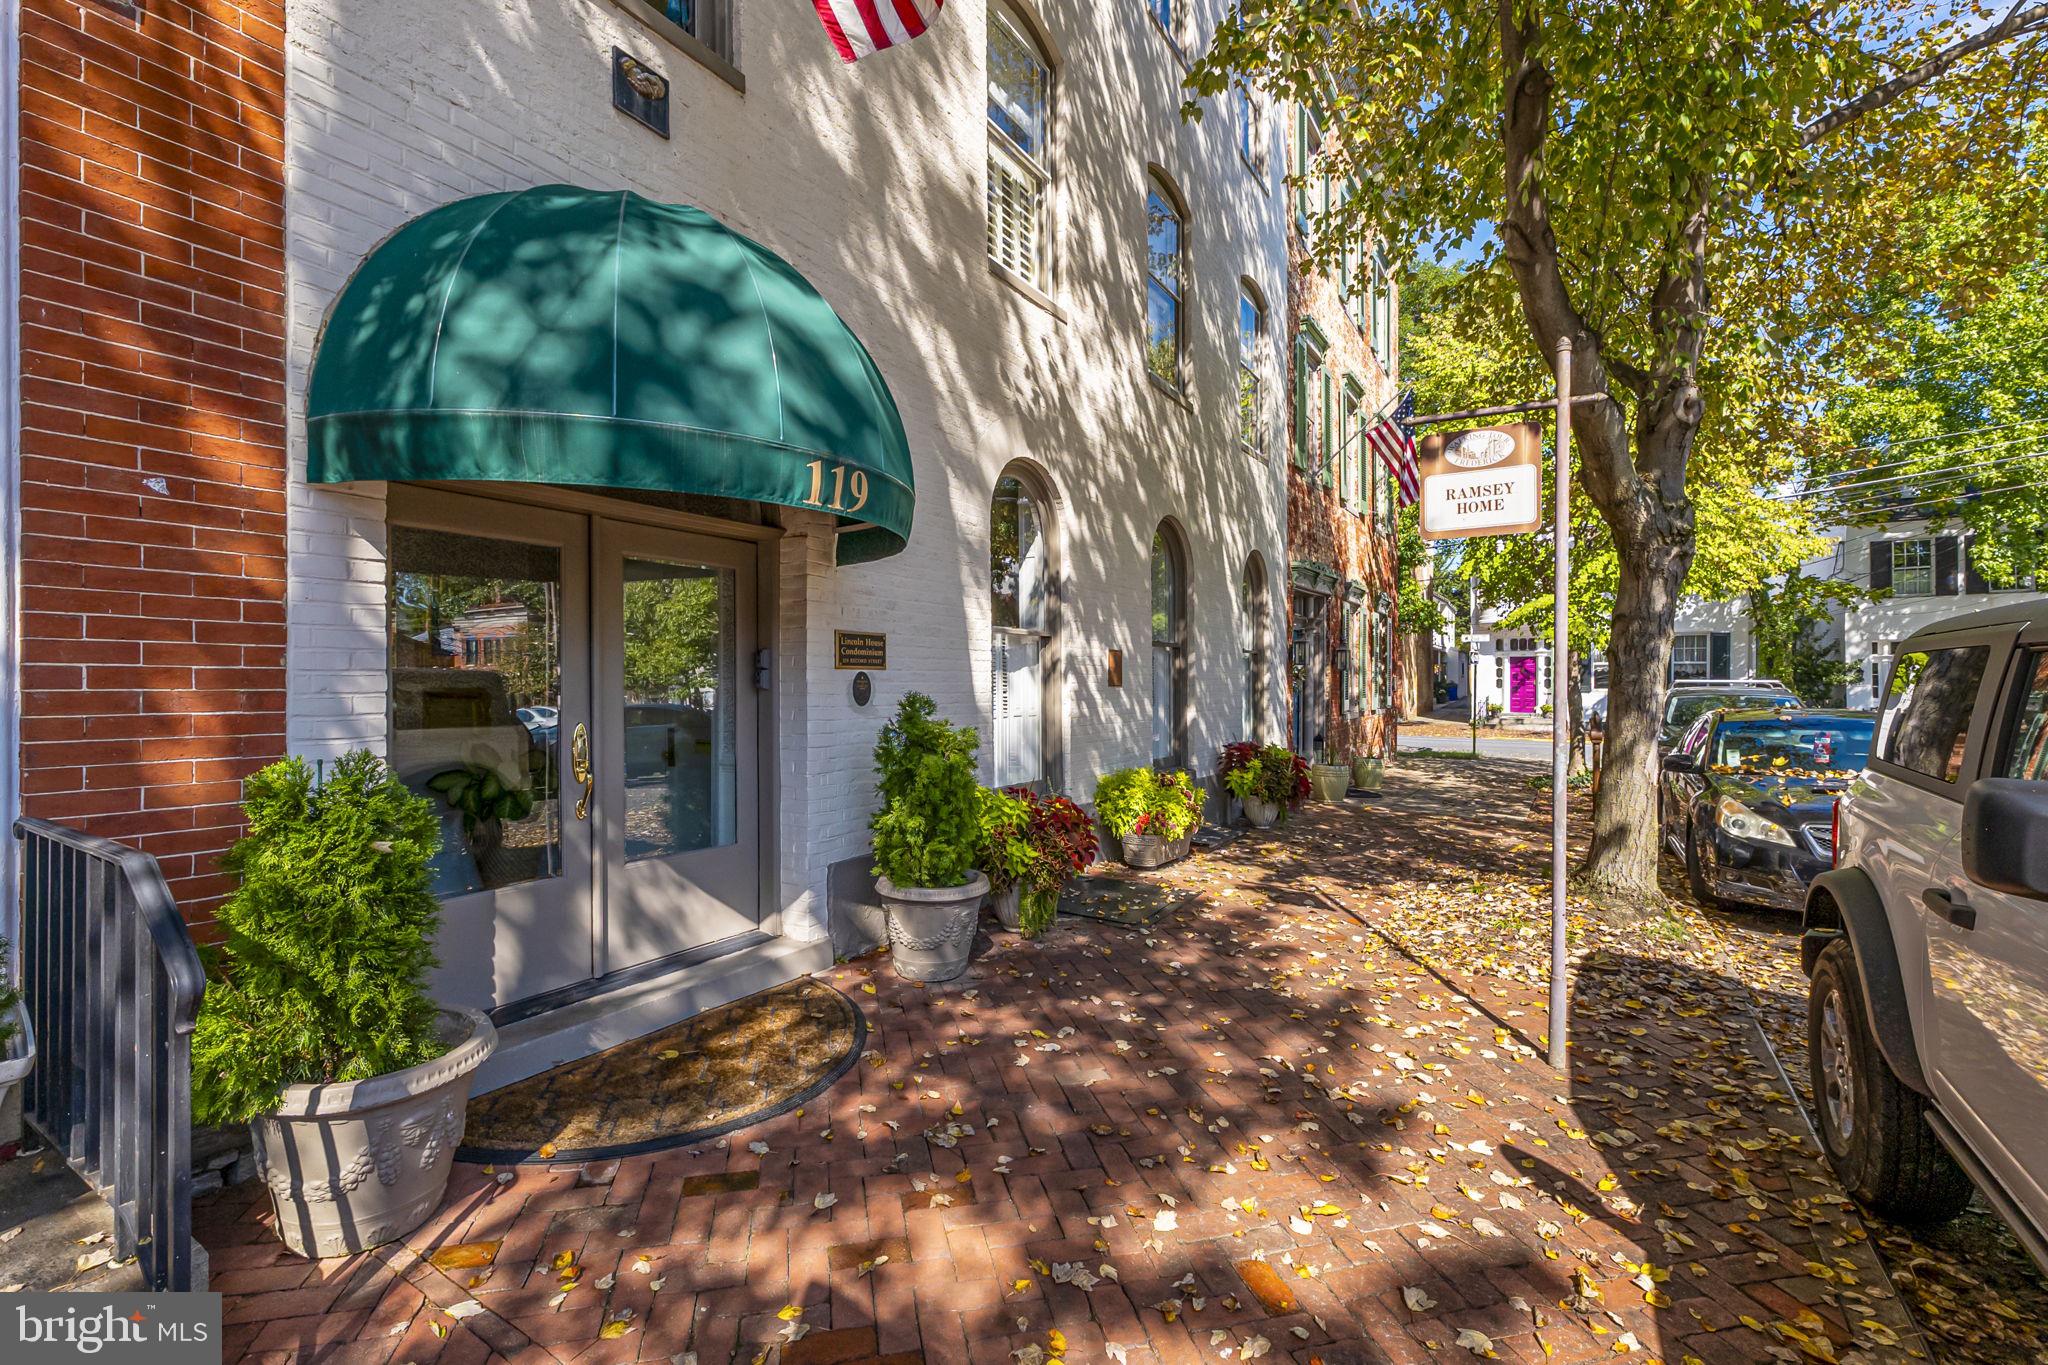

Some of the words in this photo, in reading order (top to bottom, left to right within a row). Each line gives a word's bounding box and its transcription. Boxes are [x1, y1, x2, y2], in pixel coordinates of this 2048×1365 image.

[1454, 452, 1505, 466] FREDERICK
[803, 460, 868, 512] 119
[1446, 481, 1514, 501] RAMSEY
[1457, 498, 1504, 514] HOME
[841, 637, 864, 646] Lincoln
[865, 638, 884, 647] House
[841, 647, 884, 656] Condominium
